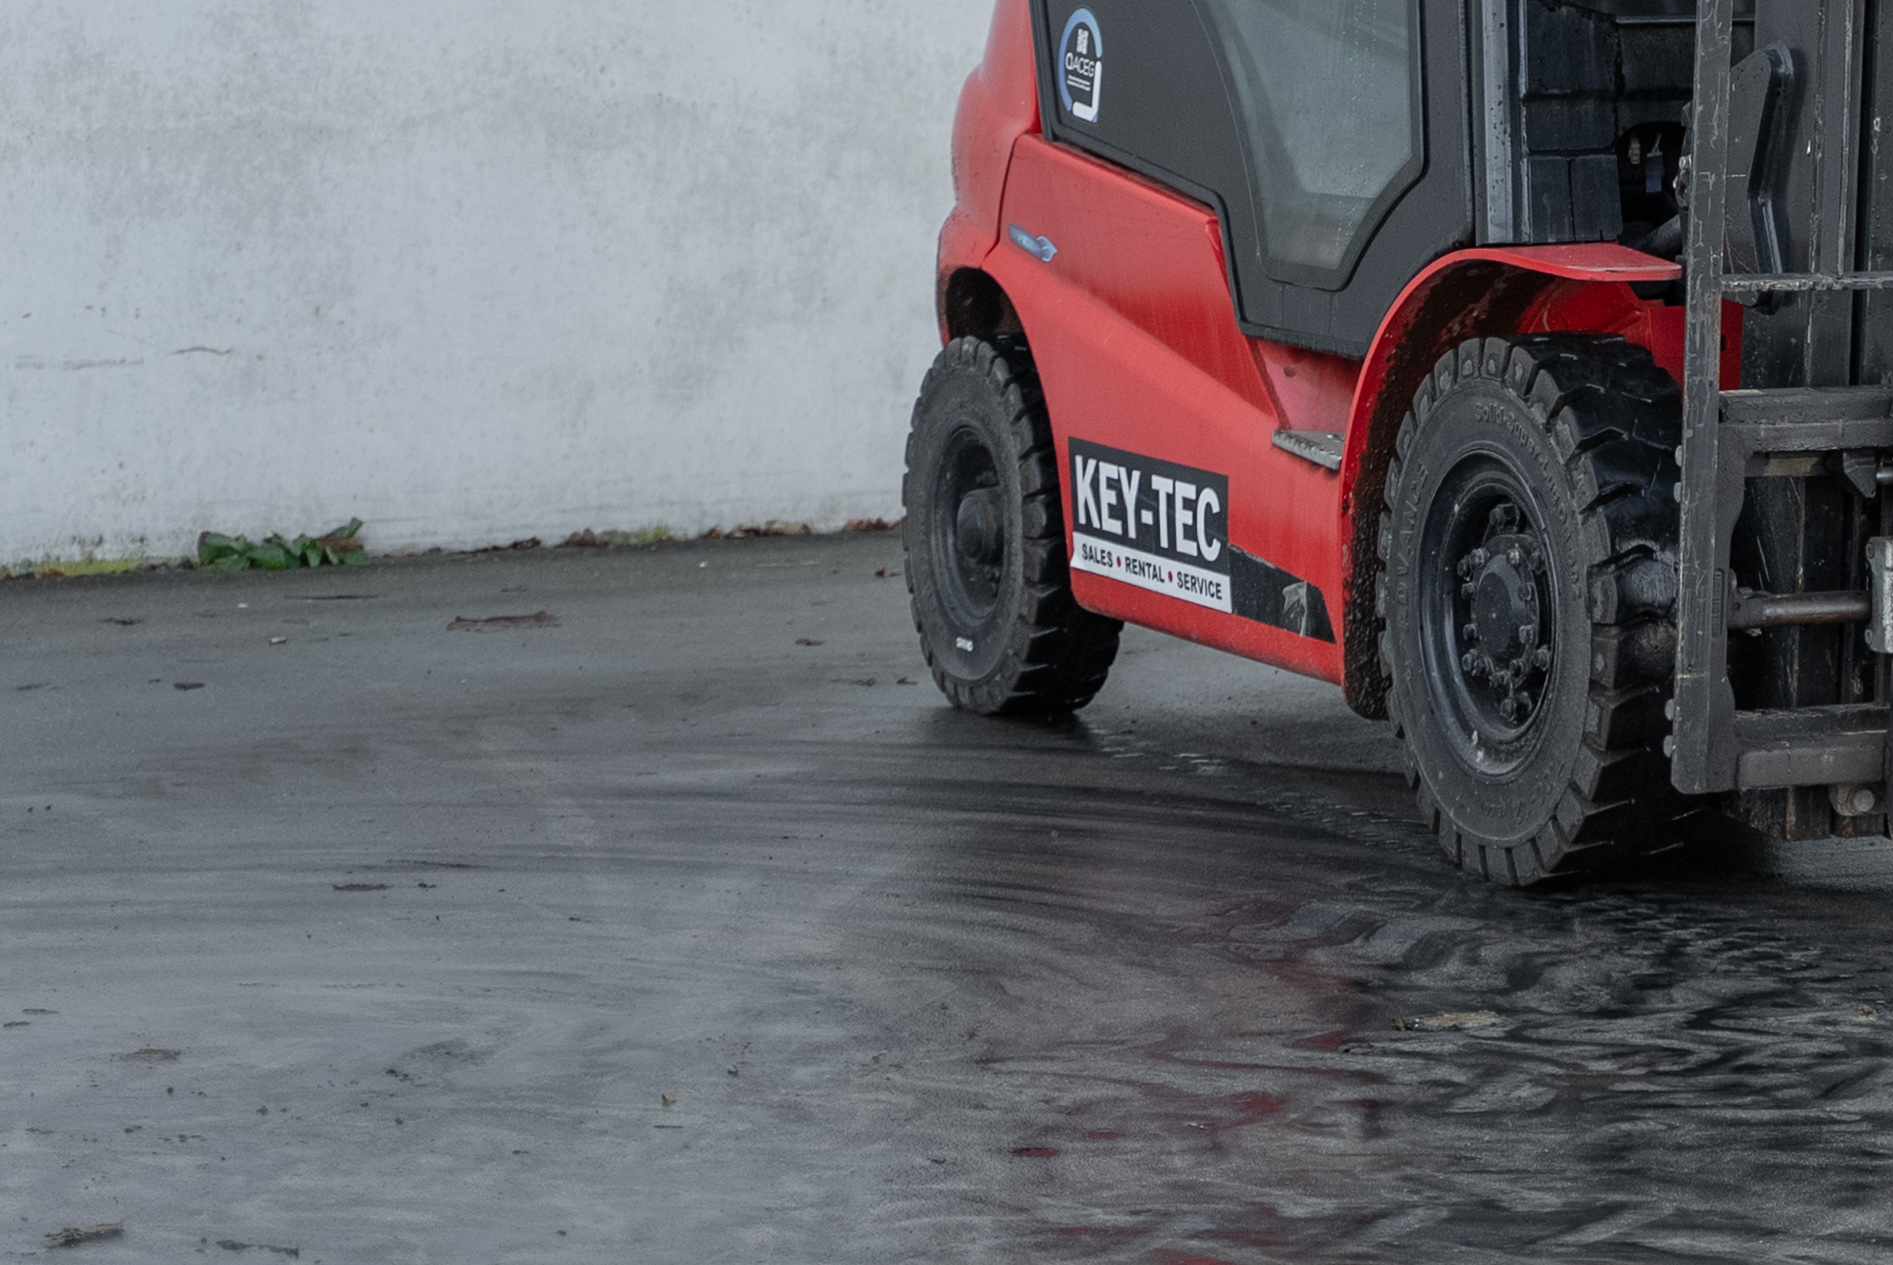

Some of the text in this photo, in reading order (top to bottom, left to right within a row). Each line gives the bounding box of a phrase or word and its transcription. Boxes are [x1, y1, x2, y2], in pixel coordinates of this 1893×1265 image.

[1075, 454, 1222, 562] KEY-TEC
[1081, 544, 1222, 600] SALES RENTAL SERVICE
